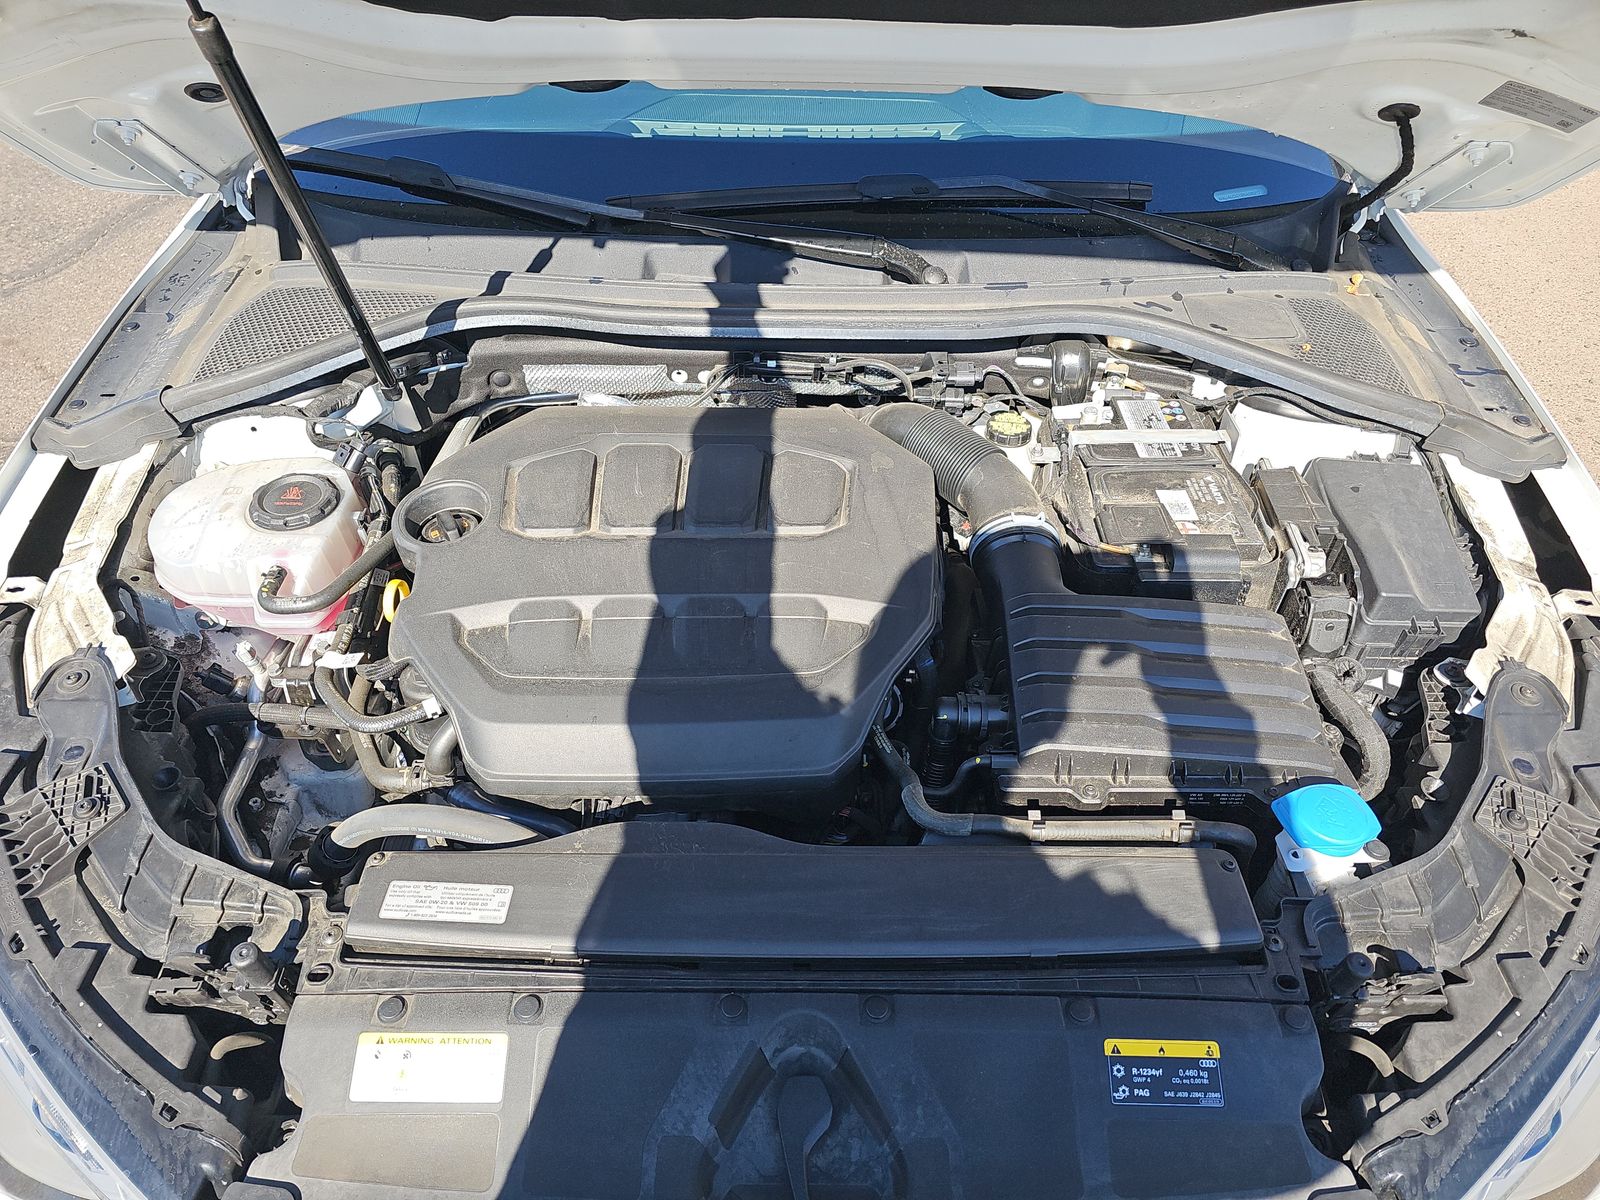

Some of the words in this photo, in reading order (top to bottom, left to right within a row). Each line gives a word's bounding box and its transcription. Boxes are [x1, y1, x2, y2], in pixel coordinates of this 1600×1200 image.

[1208, 481, 1226, 506] VARTA
[388, 1037, 434, 1045] WARNING
[440, 1037, 492, 1045] ATTENTION
[1131, 1067, 1163, 1078] R-1234yf
[1178, 1069, 1198, 1077] 0,460
[1199, 1069, 1208, 1079] kg
[1133, 1088, 1150, 1097] PAG
